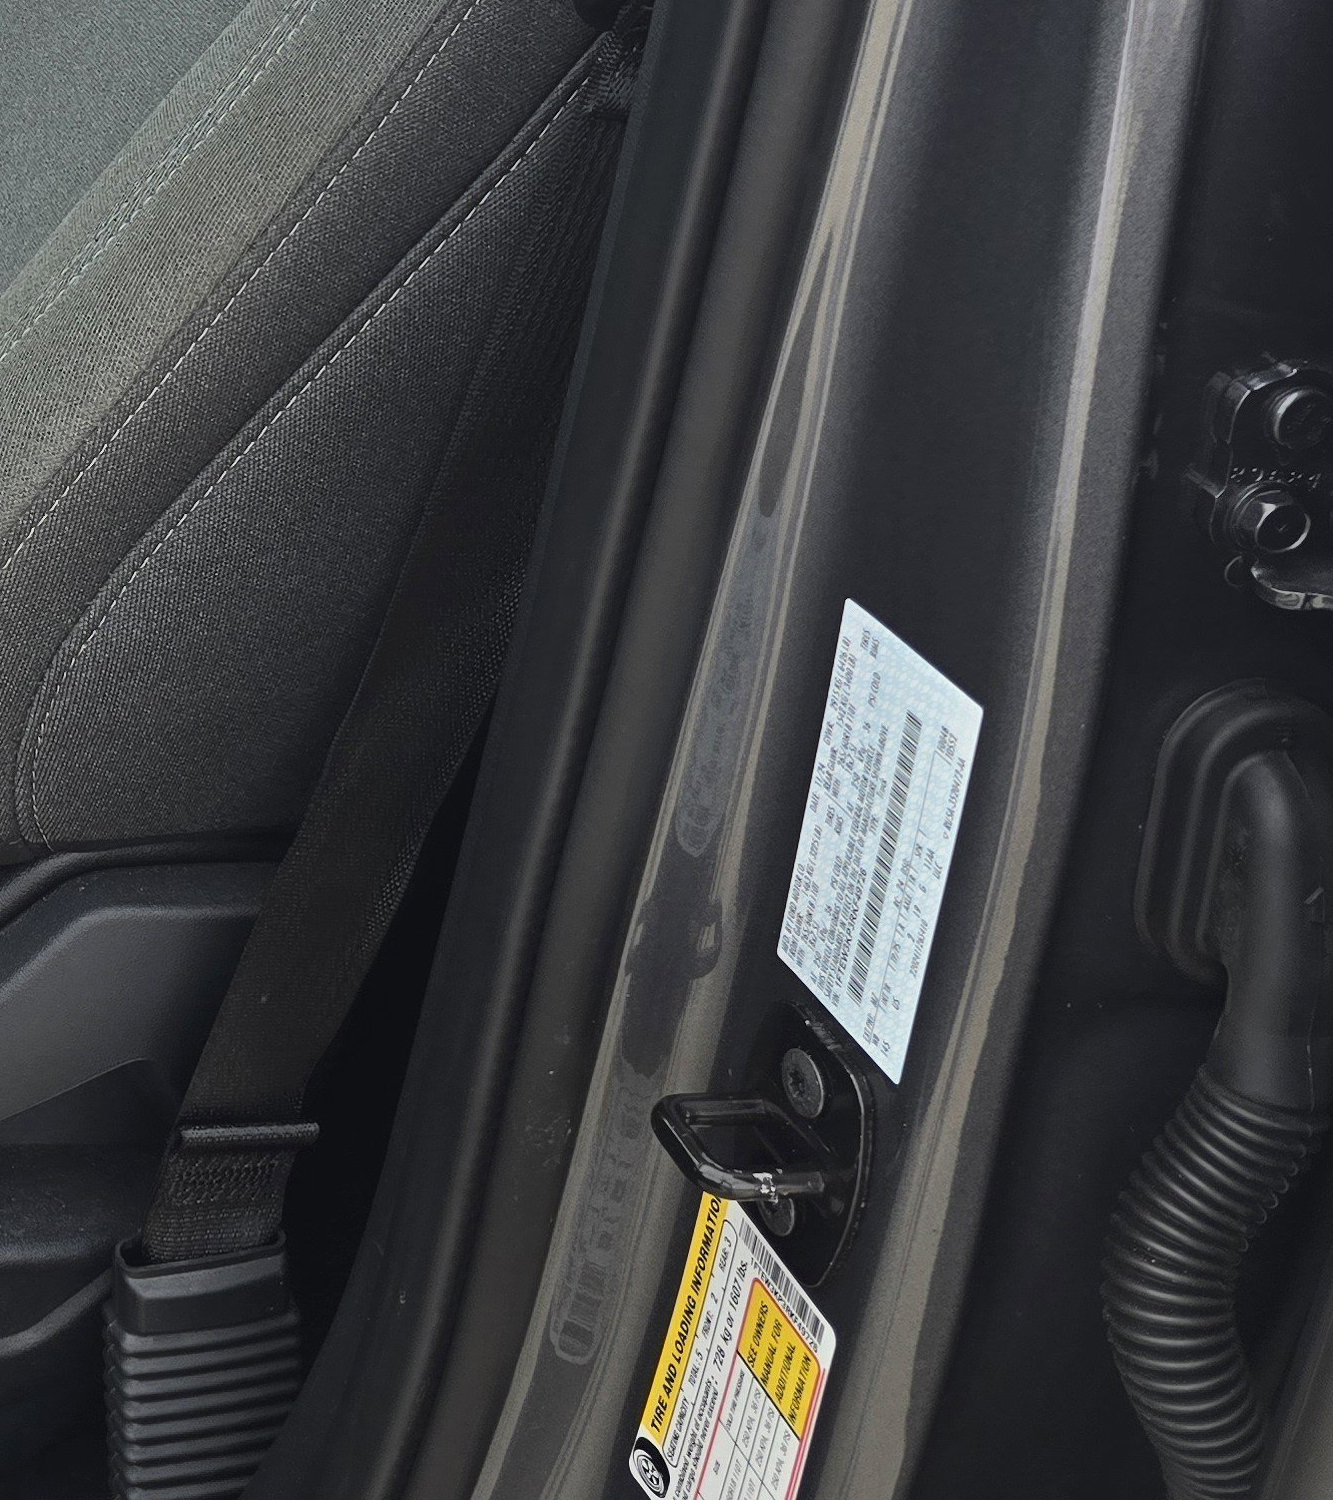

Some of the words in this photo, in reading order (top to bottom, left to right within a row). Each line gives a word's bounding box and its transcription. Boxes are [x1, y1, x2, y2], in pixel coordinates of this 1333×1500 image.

[650, 1392, 667, 1437] TIRE
[661, 1358, 677, 1400] AND
[670, 1289, 696, 1366] LOADING
[688, 1196, 724, 1297] INFORMATIO
[712, 1342, 725, 1374] 728
[728, 1276, 742, 1312] 1607
[735, 1252, 748, 1282] lbs.
[751, 1298, 769, 1349] OWNERS
[746, 1342, 758, 1369] SEE
[758, 1338, 777, 1388] MANUAL
[770, 1315, 782, 1345] FOR
[773, 1336, 796, 1404] ADDITIONAL
[785, 1350, 813, 1428] INFORMATION
[666, 1427, 679, 1462] SEATING
[674, 1394, 689, 1434] CAPACITY
